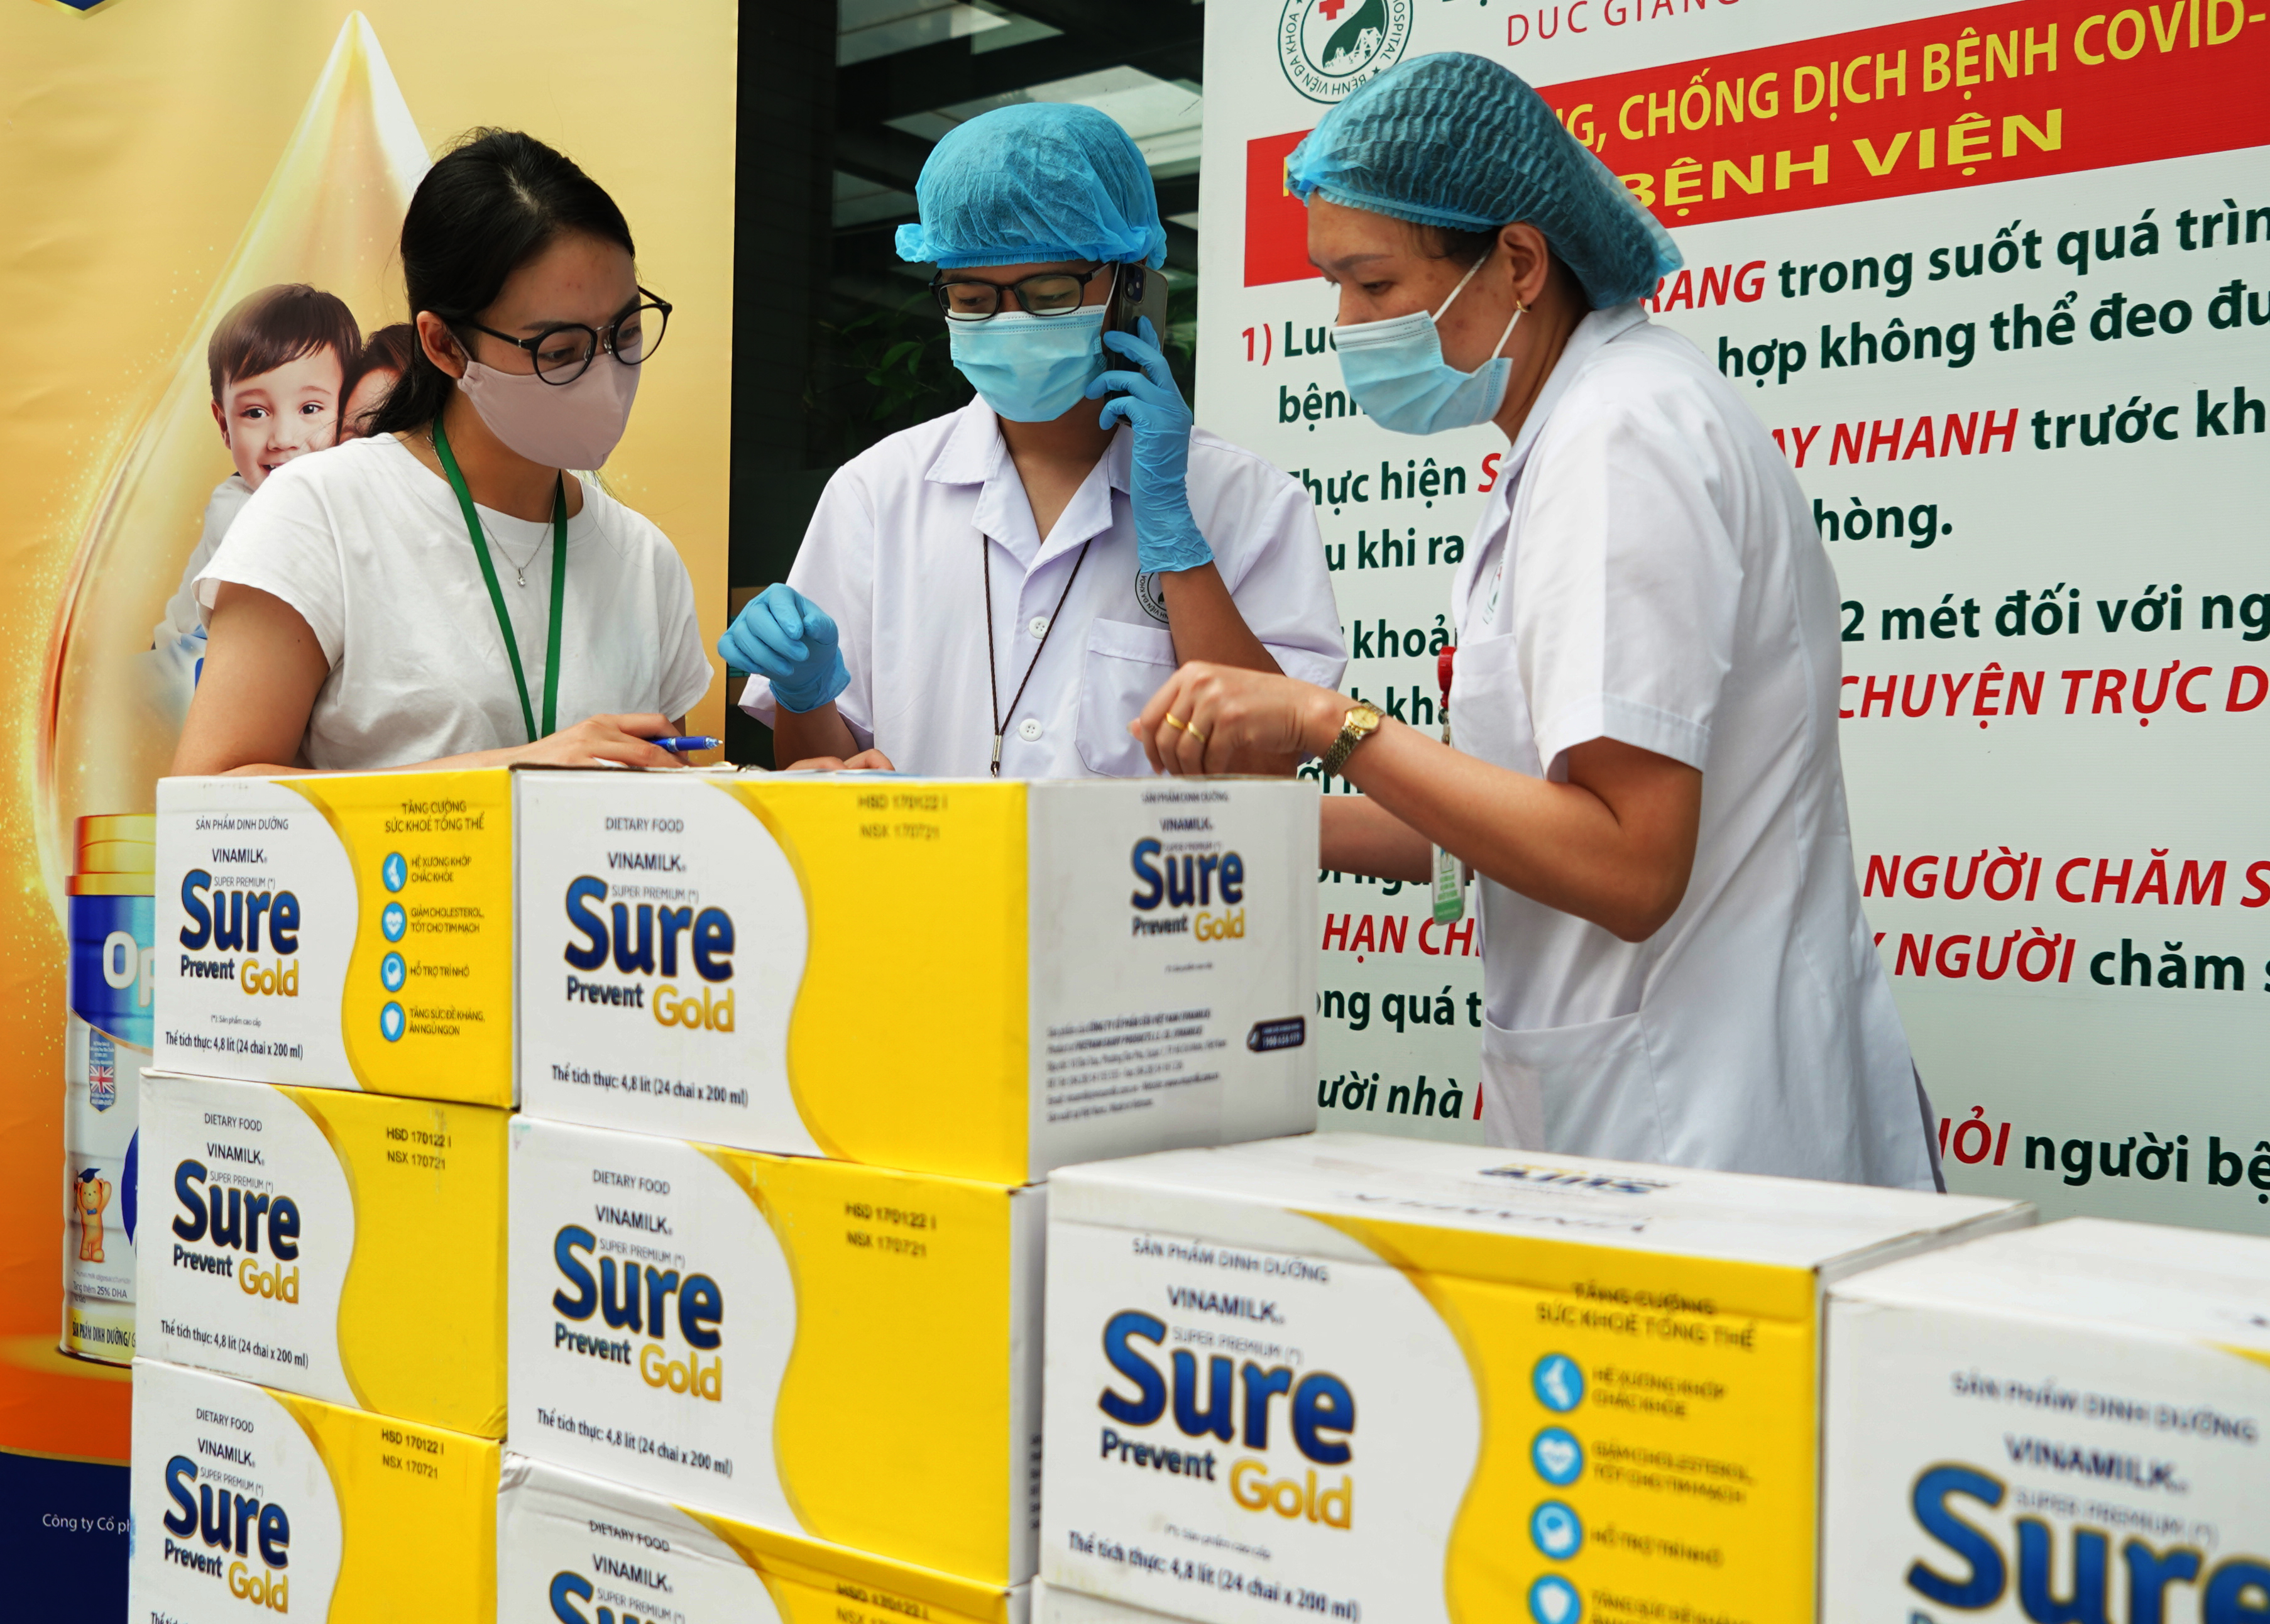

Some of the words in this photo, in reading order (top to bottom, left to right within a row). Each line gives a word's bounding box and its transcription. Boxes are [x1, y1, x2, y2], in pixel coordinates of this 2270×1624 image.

[1286, 13, 1300, 54] KHOA
[1380, 0, 1405, 60] OSPITAL
[1508, 1, 1588, 47] DUC
[1604, 0, 1740, 26] GIA
[1290, 55, 1305, 76] ĐA
[1302, 73, 1327, 95] VIỆN
[1618, 68, 1779, 140] CHỐNG
[1794, 61, 1906, 121] DỊCH
[1923, 24, 2057, 100] BỆNH
[1617, 144, 1829, 217] BỆNH
[1853, 108, 2063, 175] VIỆN
[1242, 323, 1272, 366] 1)
[1285, 321, 1337, 358] Lu
[1640, 260, 1766, 313] RANG
[1778, 253, 1912, 298] trong
[1928, 220, 2042, 282] suốt
[2058, 208, 2159, 275] quá
[2176, 198, 2270, 251] trìn
[1718, 336, 1807, 388] hợp
[1821, 317, 1975, 368] không
[1990, 290, 2078, 351] thể
[2090, 292, 2193, 341] đeo
[1381, 458, 1466, 508] hiện
[1478, 453, 1501, 492] S
[1829, 408, 2019, 466] NHANH
[2031, 396, 2179, 450] trước
[2196, 386, 2266, 437] kh
[1325, 544, 1345, 571] u
[1358, 527, 1415, 569] khi
[1428, 535, 1464, 565] ra
[1813, 497, 1953, 549] hòng.
[1353, 614, 1457, 659] khoả
[1841, 600, 1864, 642] 2
[1882, 594, 1980, 640] mét
[1995, 583, 2080, 636] đối
[2097, 583, 2183, 633] với
[2202, 593, 2270, 642] ng
[1386, 686, 1449, 725] kh
[1839, 661, 2045, 729] CHUYỆN
[2061, 659, 2213, 727] TRỰC
[2225, 666, 2269, 712] D
[196, 815, 211, 830] SẢN
[213, 813, 234, 830] PHẨM
[237, 819, 256, 830] DINH
[259, 816, 288, 830] DƯỠNG
[605, 816, 650, 831] DIETARY
[652, 818, 684, 833] FOOD
[214, 877, 234, 887] SUPER
[236, 877, 265, 887] PREMIUM
[1131, 837, 1244, 911] Sure
[1863, 846, 2042, 902] NGƯỜI
[2056, 848, 2227, 906] CHĂM
[180, 868, 300, 955] Sure
[564, 874, 736, 983] Sure
[1132, 914, 1188, 936] Prevent
[1195, 908, 1245, 942] Gold
[103, 931, 155, 1007] Op
[180, 954, 235, 980] Prevent
[241, 957, 299, 997] Gold
[1322, 914, 1408, 963] HẠN
[1418, 917, 1480, 957] CH
[1894, 927, 2076, 984] NGƯỜI
[2090, 938, 2244, 991] chăm
[567, 975, 644, 1009] Prevent
[653, 984, 735, 1033] Gold
[1316, 990, 1370, 1031] ng
[1382, 985, 1454, 1033] quá
[1466, 992, 1482, 1027] t
[166, 1029, 177, 1045] Thể
[180, 1033, 192, 1046] tích
[194, 1034, 212, 1052] thực:
[214, 1037, 225, 1052] 4,8
[237, 1039, 248, 1054] (24
[250, 1040, 265, 1055] chai
[268, 1045, 271, 1055] x
[274, 1043, 288, 1056] 200
[290, 1044, 304, 1061] ml)
[205, 1112, 237, 1128] DIETARY
[239, 1117, 262, 1132] FOOD
[387, 1126, 408, 1141] HSD
[412, 1131, 445, 1147] 170122
[1317, 1070, 1379, 1111] ười
[1387, 1075, 1463, 1119] nhà
[2025, 1132, 2188, 1186] người
[2208, 1136, 2270, 1204] bệ
[210, 1171, 231, 1184] SUPER
[234, 1175, 264, 1189] PREMIUM
[387, 1149, 408, 1164] NSX
[412, 1153, 445, 1170] 170721
[593, 1169, 635, 1188] DIETARY
[639, 1177, 671, 1194] FOOD
[172, 1158, 300, 1261] Sure
[97, 1286, 111, 1296] 25%
[112, 1288, 127, 1298] DHA
[173, 1244, 233, 1277] Prevent
[239, 1258, 299, 1304] Gold
[552, 1224, 723, 1351] Sure
[161, 1319, 175, 1335] Thể
[177, 1324, 191, 1339] tích
[193, 1327, 212, 1346] thực:
[214, 1333, 226, 1348] 4,8
[228, 1334, 236, 1350] lít
[239, 1337, 251, 1354] (24
[253, 1342, 268, 1358] chai
[271, 1350, 275, 1359] x
[277, 1348, 292, 1363] 200
[295, 1351, 309, 1369] ml)
[555, 1321, 632, 1365] Prevent
[640, 1342, 722, 1402] Gold
[1099, 1309, 1356, 1466] Sure
[197, 1408, 229, 1426] DIETARY
[231, 1417, 254, 1433] FOOD
[381, 1428, 402, 1444] HSD
[405, 1435, 438, 1454] 170122
[383, 1454, 402, 1469] NSX
[407, 1459, 437, 1479] 170721
[1100, 1428, 1216, 1482] Prevent
[1229, 1456, 1352, 1530] Gold
[43, 1513, 77, 1532] Công
[81, 1517, 94, 1532] ty
[97, 1516, 114, 1531] Cổ
[163, 1454, 290, 1570] Sure
[1904, 1460, 2270, 1624] Sure
[165, 1537, 222, 1579] Prevent
[229, 1561, 289, 1614] Gold
